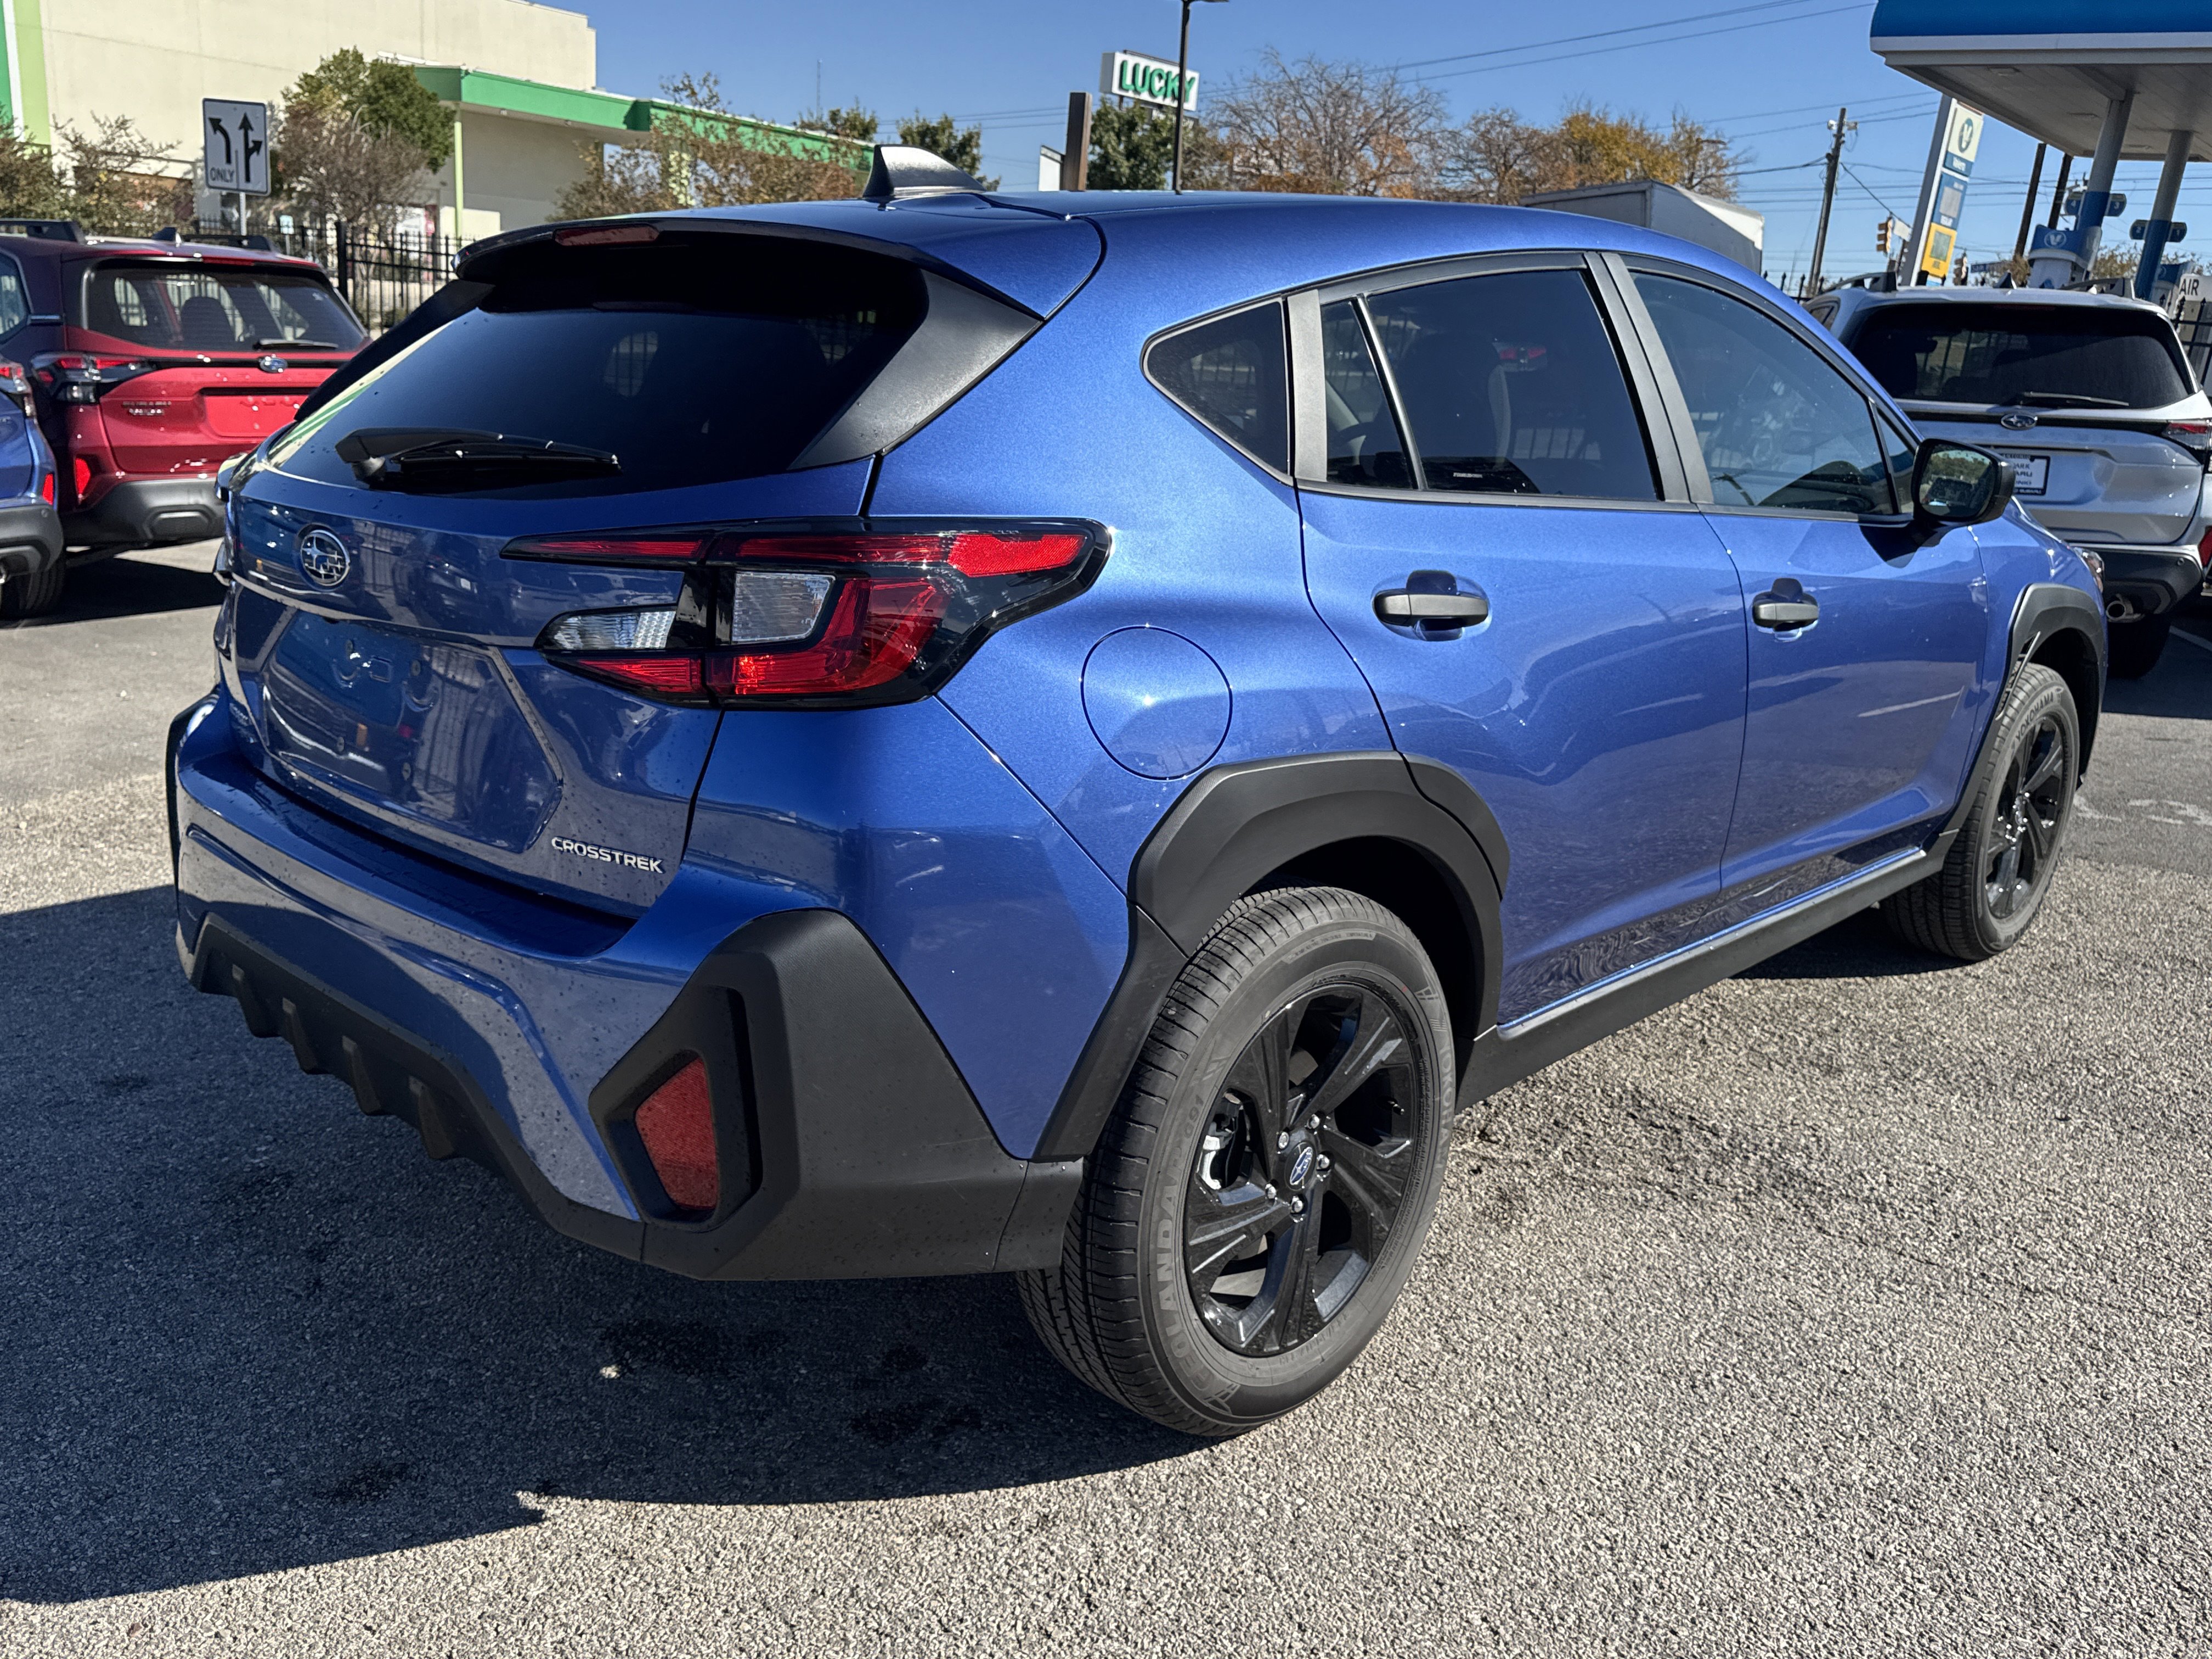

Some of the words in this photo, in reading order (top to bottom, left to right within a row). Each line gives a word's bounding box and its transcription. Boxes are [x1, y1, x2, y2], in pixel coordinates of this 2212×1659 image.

[1120, 60, 1195, 103] LUCKY
[210, 167, 235, 183] ONLY
[2179, 278, 2199, 296] AIR
[2015, 691, 2053, 742] YOKOHAMA
[551, 837, 663, 873] CROSSTREK
[1156, 1147, 1211, 1392] GEOLANDAR
